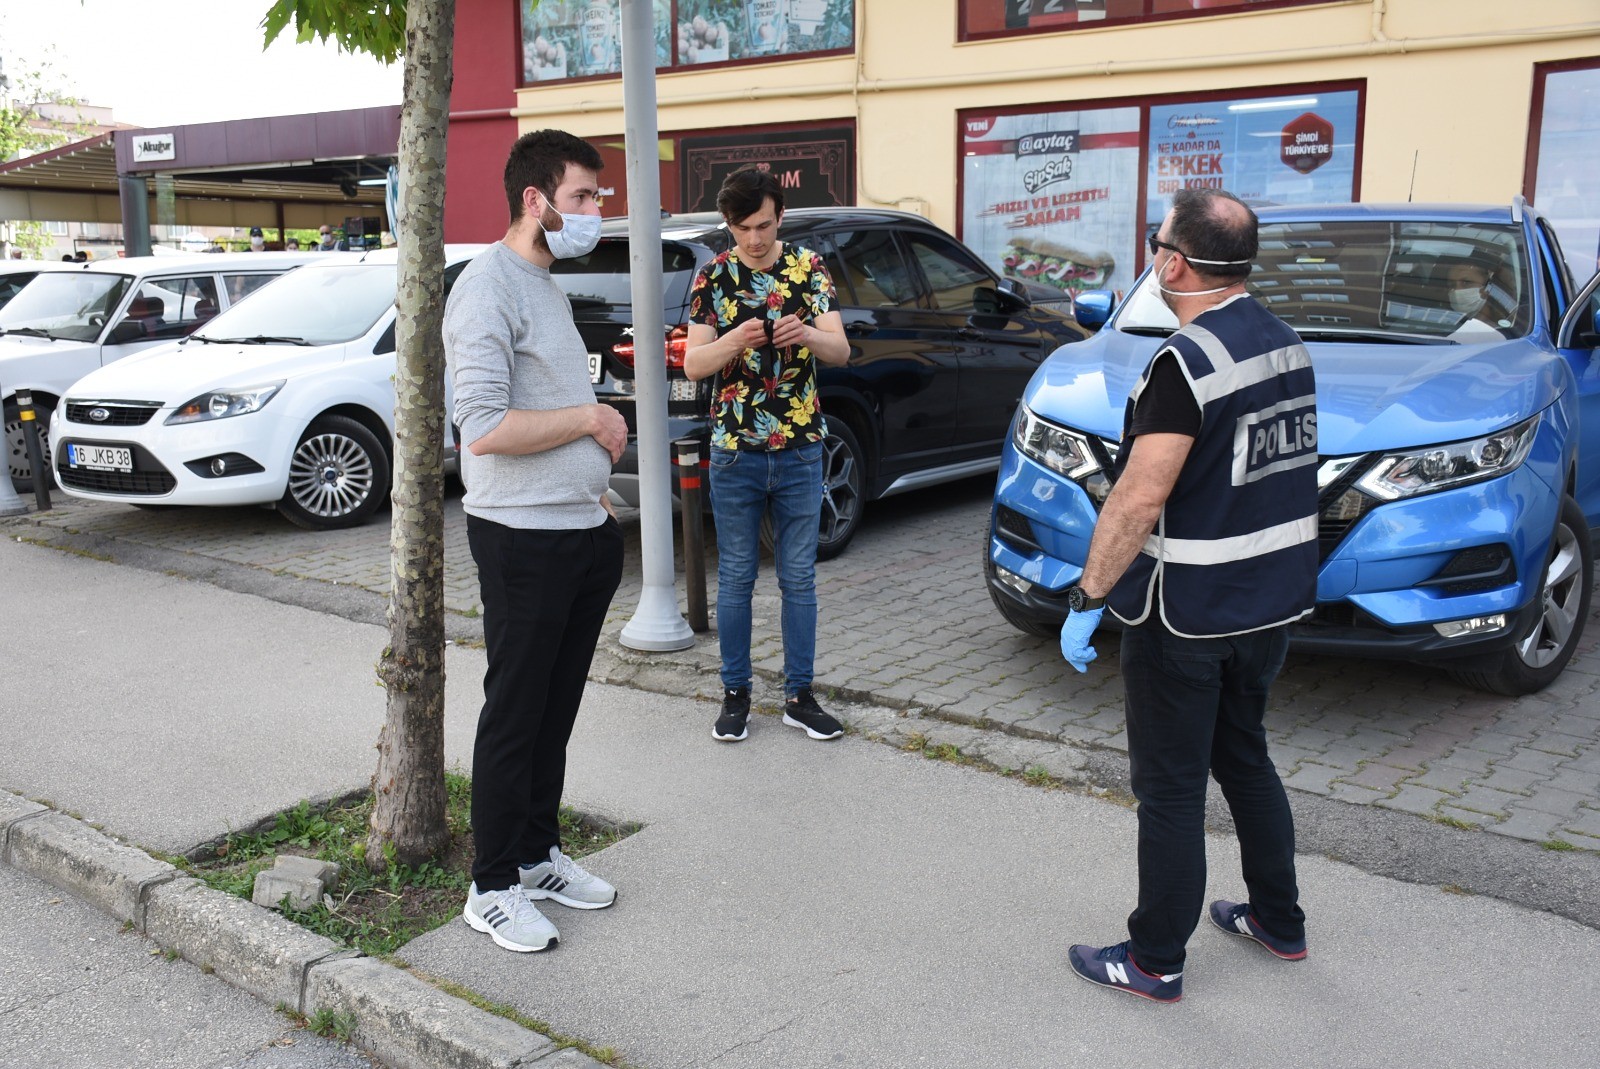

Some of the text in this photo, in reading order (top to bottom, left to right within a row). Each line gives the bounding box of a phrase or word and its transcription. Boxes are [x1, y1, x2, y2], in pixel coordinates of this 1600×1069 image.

[966, 120, 988, 132] YENİ
[1295, 131, 1319, 144] ŞİMDİ
[1158, 140, 1220, 153] NE KADAR DA
[1285, 144, 1329, 156] TÜRKİYE'DE
[1157, 152, 1223, 176] ERKEK
[995, 200, 1029, 214] HIZLI
[1032, 197, 1049, 209] VE
[1024, 206, 1081, 226] SALAM
[75, 447, 130, 466] 16 JKB 38
